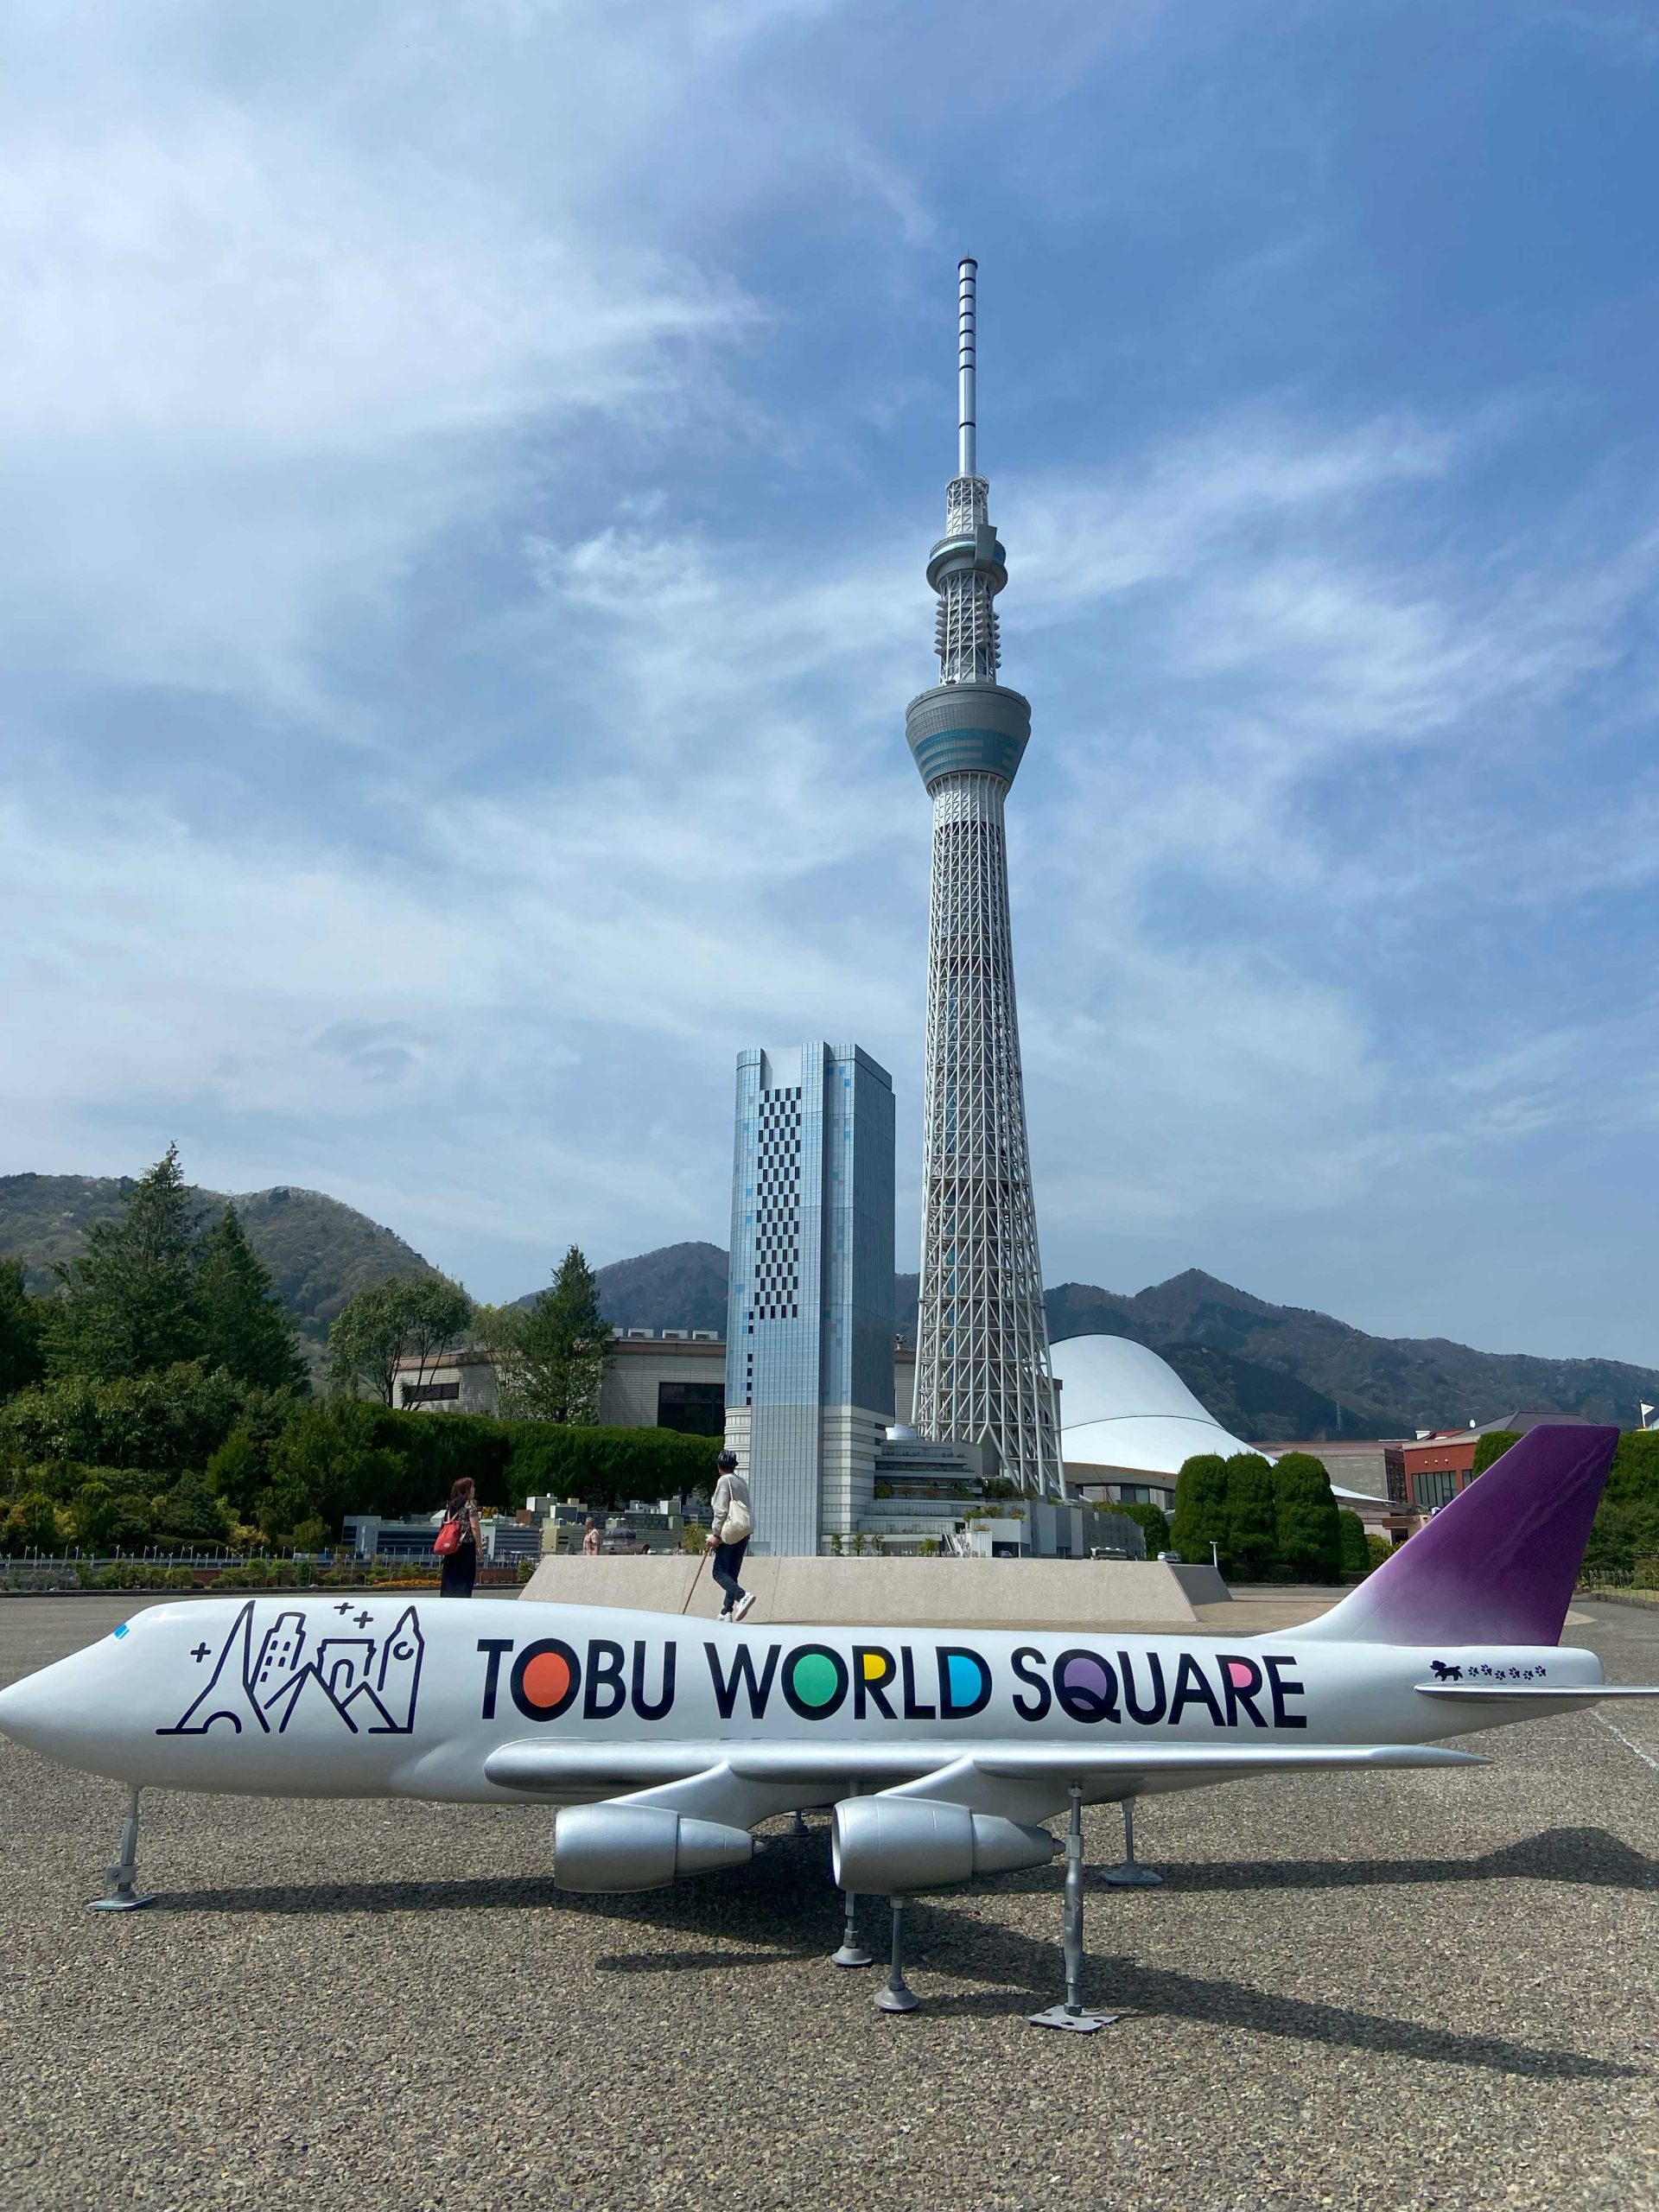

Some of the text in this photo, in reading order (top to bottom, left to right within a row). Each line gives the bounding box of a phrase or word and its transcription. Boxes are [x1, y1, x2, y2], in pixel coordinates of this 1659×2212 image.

[477, 1638, 1307, 1728] TOBU WORLD SQUARE
